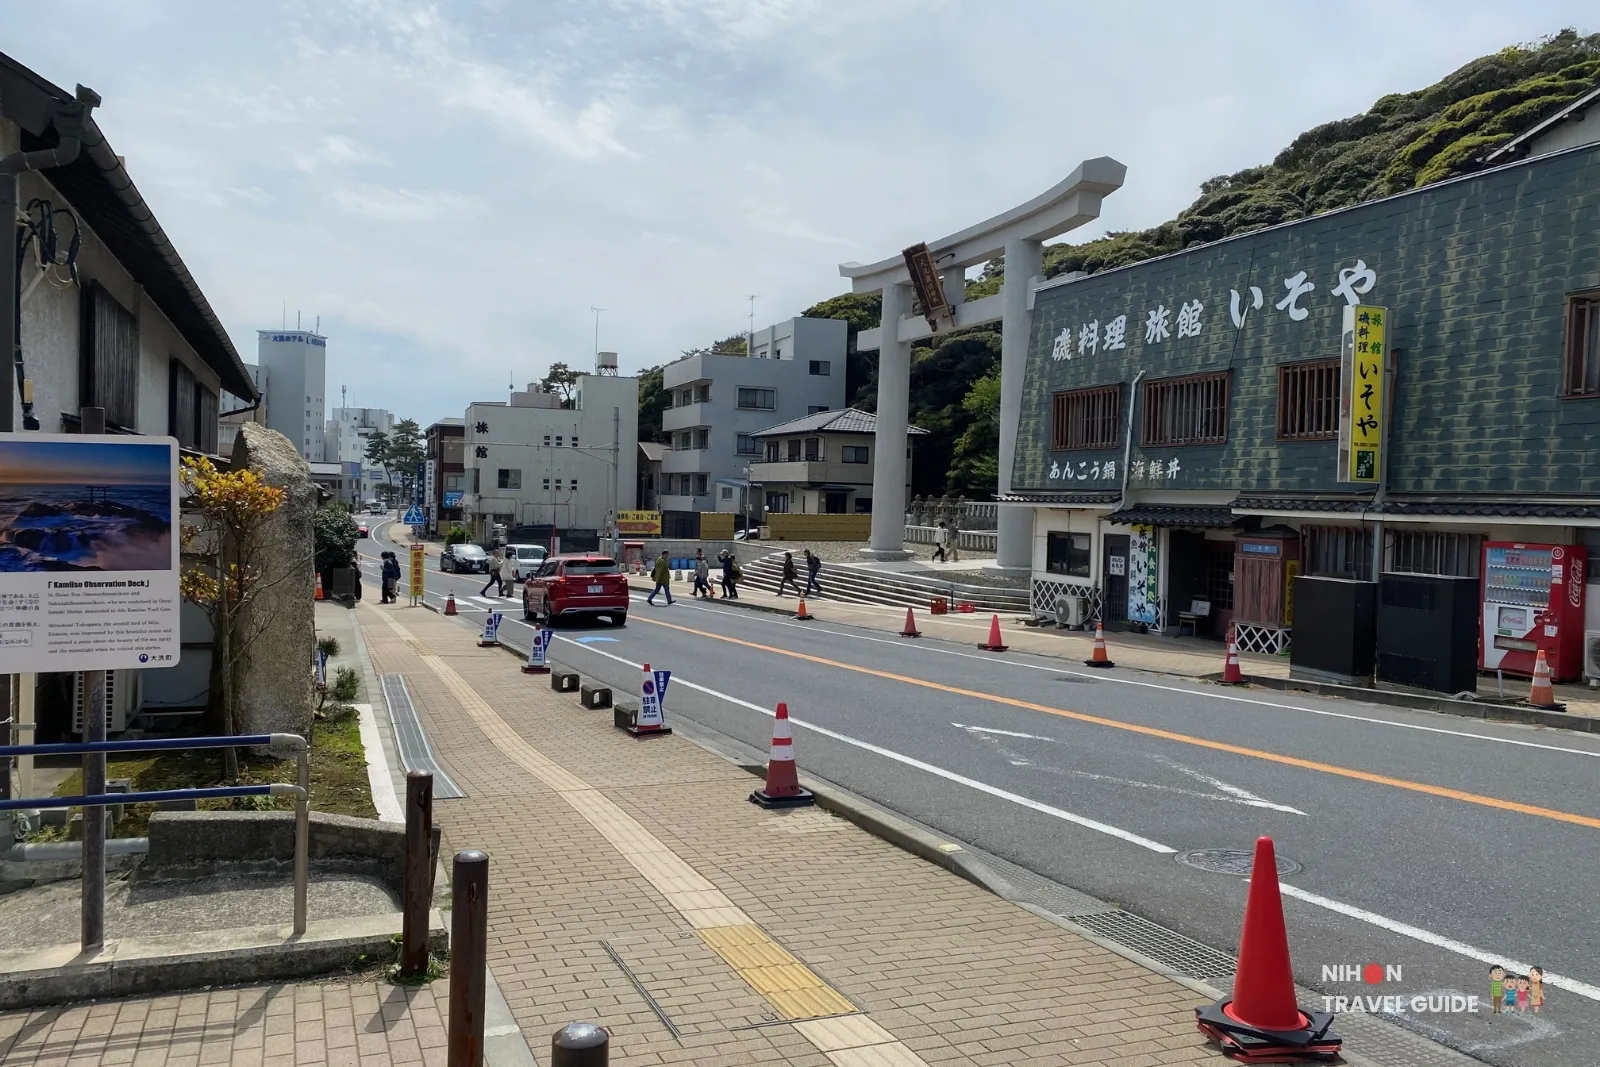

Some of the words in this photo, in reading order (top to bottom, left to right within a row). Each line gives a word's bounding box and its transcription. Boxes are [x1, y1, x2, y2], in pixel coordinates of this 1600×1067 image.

[1052, 315, 1126, 362] 磯料理
[1145, 298, 1204, 344] 旅館
[1230, 259, 1376, 330] いそや
[1358, 312, 1370, 353] 磯料理
[1370, 313, 1382, 355] 旅館
[1356, 360, 1378, 438] いそや
[1049, 460, 1116, 480] あんこう鍋
[1131, 458, 1180, 480] 海鮮丼
